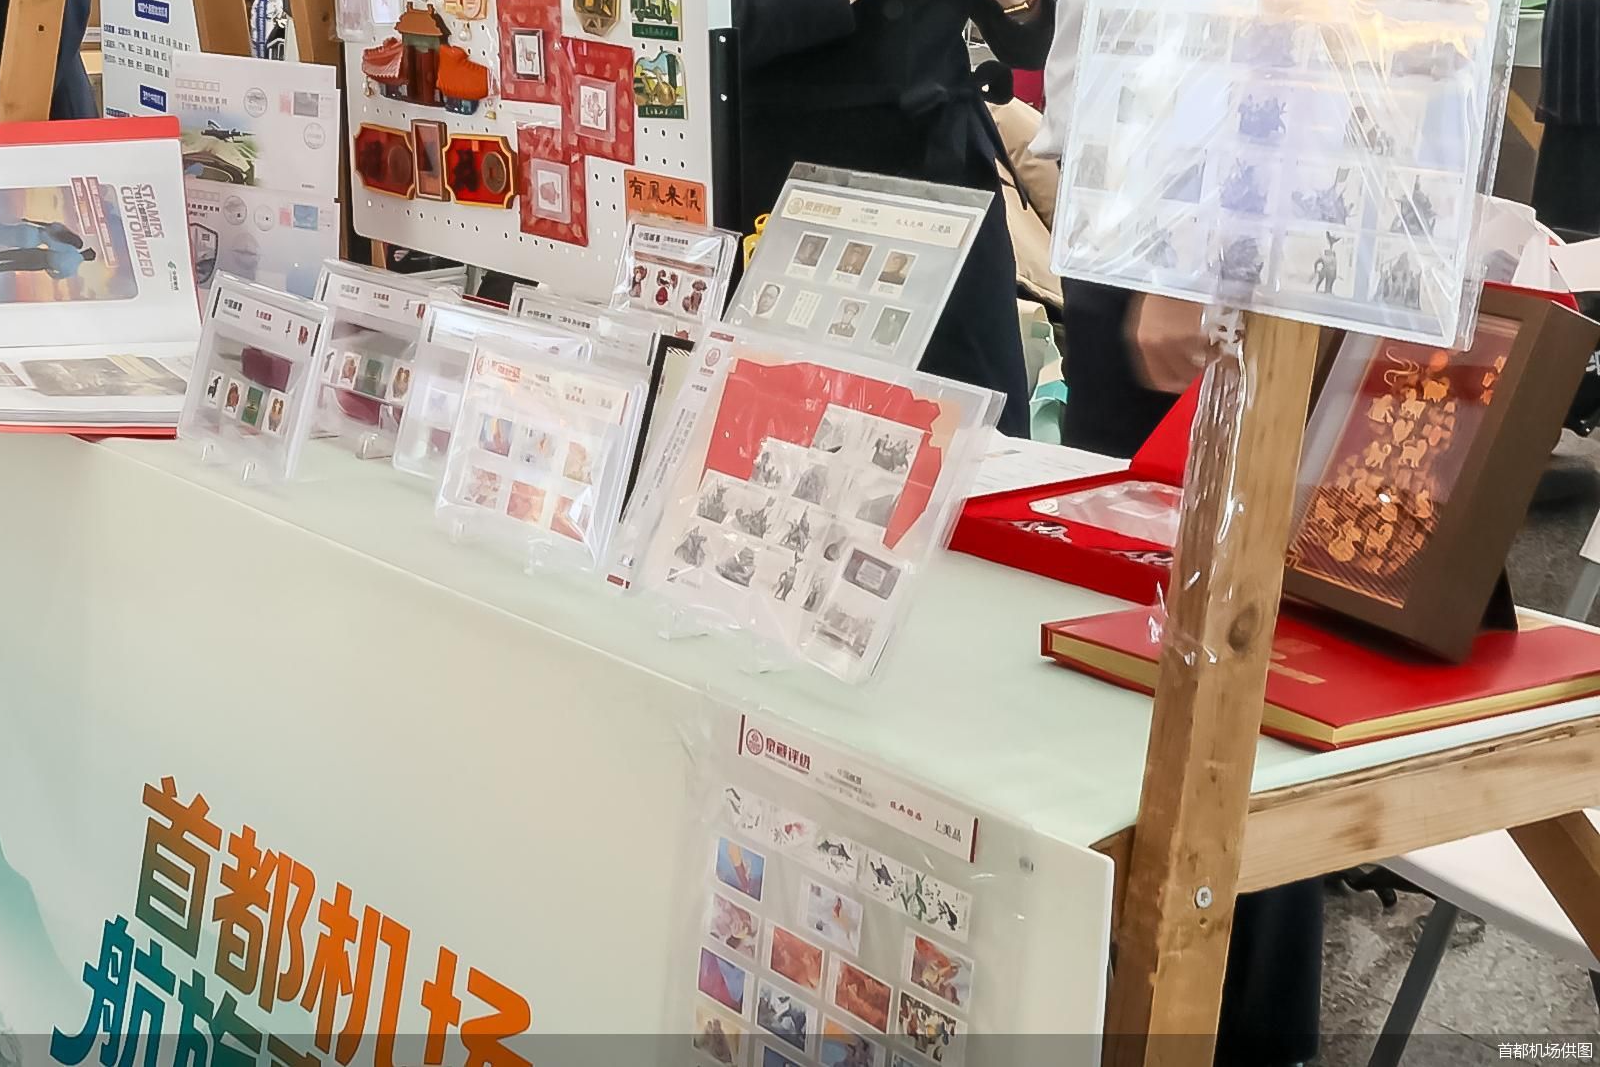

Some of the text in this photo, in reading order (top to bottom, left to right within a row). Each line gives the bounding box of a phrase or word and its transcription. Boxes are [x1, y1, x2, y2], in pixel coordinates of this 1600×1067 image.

[120, 185, 155, 279] CUSTOMIZED
[141, 183, 165, 239] STAMPS
[135, 775, 534, 1067] 首都机场
[49, 914, 323, 1067] 航旅
